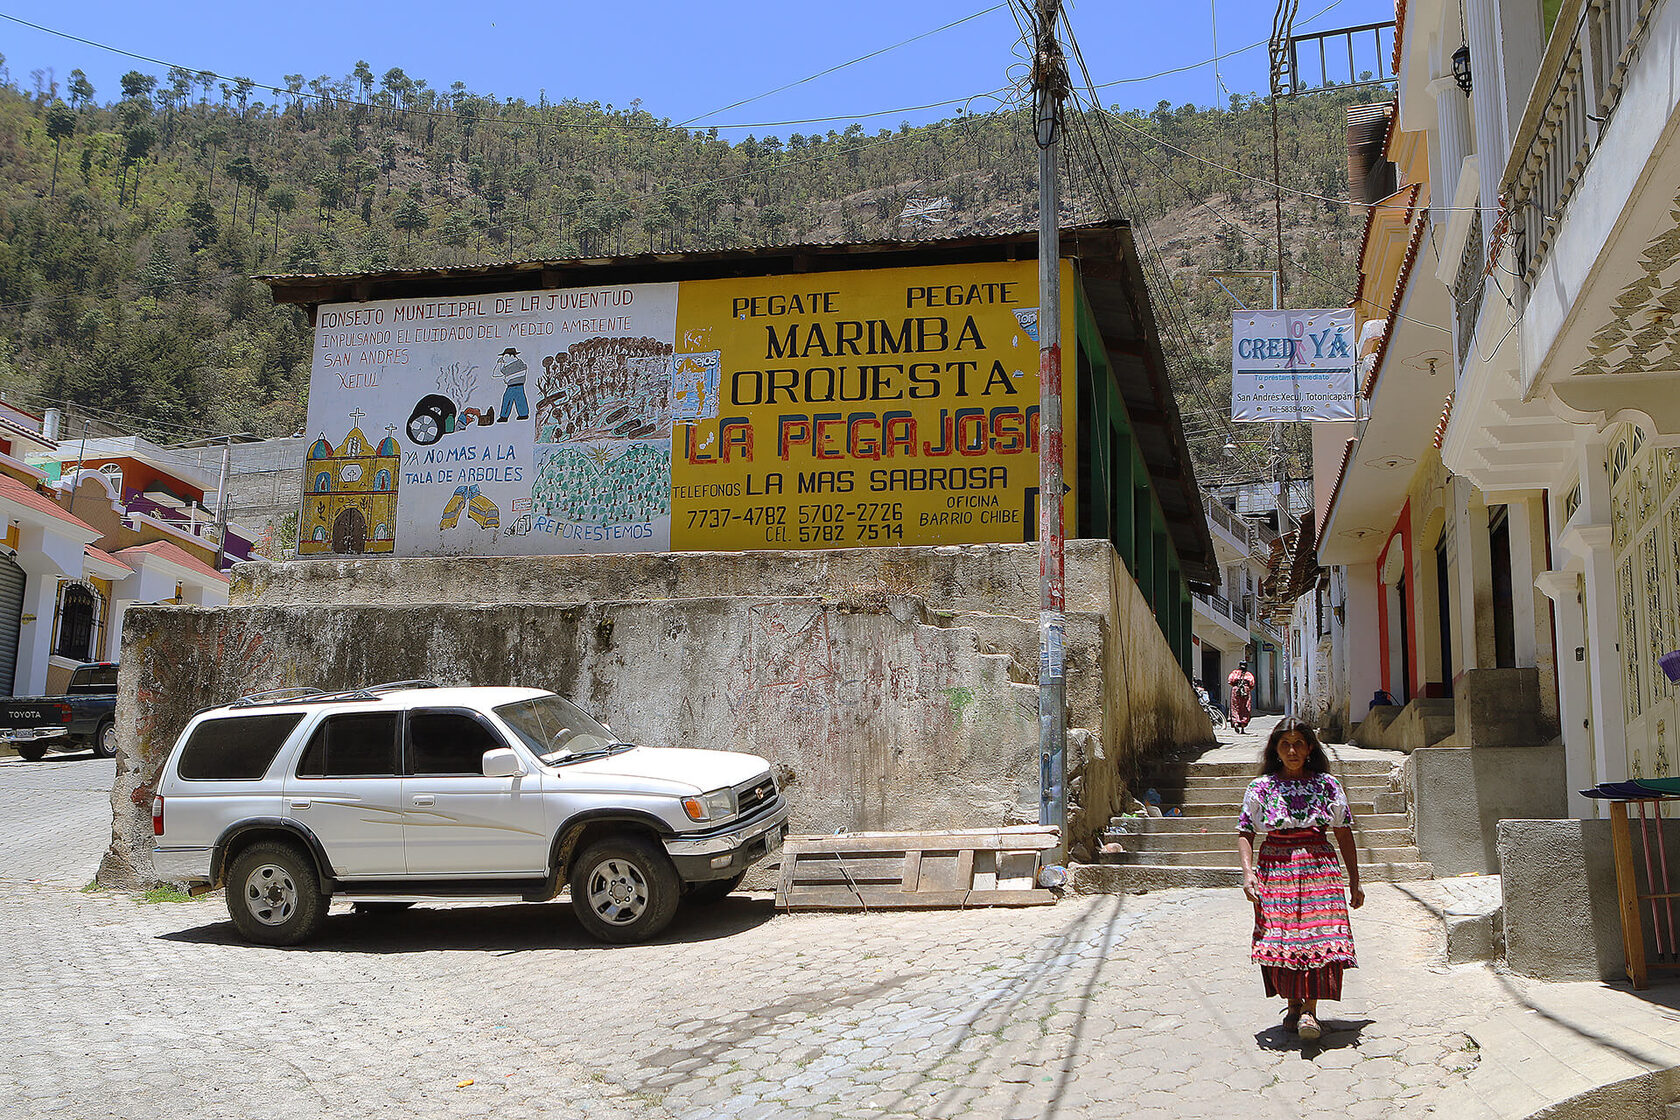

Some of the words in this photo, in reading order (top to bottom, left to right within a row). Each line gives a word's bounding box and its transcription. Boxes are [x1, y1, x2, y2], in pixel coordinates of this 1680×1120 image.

[321, 309, 384, 329] CONSEJO
[393, 301, 486, 322] MUNICIPAL
[495, 298, 514, 314] DE
[520, 296, 540, 311] LA
[546, 290, 634, 310] JUVENTUD
[733, 291, 840, 318] PEGATE
[906, 282, 1019, 308] PEGATE
[321, 330, 391, 348] IMPULSANDO
[397, 330, 411, 344] EL
[415, 326, 474, 343] CUIDADO
[477, 325, 501, 338] DEL
[508, 321, 554, 337] MEDIO
[561, 316, 632, 333] AMBIENTE
[765, 315, 987, 359] MARIMBA
[323, 352, 351, 368] SAN
[360, 348, 410, 365] ANDRES
[731, 360, 1017, 406] ORQUESTA
[1237, 393, 1251, 402] San
[1252, 392, 1281, 402] Andrés
[684, 416, 754, 465] LA
[404, 451, 419, 466] YA
[423, 449, 444, 464] NO
[446, 446, 477, 463] MAS
[482, 446, 491, 461] A
[497, 444, 516, 461] LA
[405, 472, 433, 484] TALA
[438, 470, 453, 483] DE
[458, 467, 523, 482] ARBOLES
[672, 482, 742, 499] TELEFONOS
[746, 472, 783, 496] LA
[798, 470, 855, 494] MAS
[869, 466, 1008, 492] SABROSA
[946, 495, 999, 509] OFICINA
[534, 515, 653, 541] REFORESTEMOS
[687, 506, 787, 529] 7737-4782
[798, 502, 903, 524] 5702-2726
[920, 511, 973, 526] BARRIO
[980, 509, 1020, 523] CHIBE
[799, 525, 845, 542] 5782
[856, 523, 904, 540] 7514
[9, 711, 41, 719] TOYOTA
